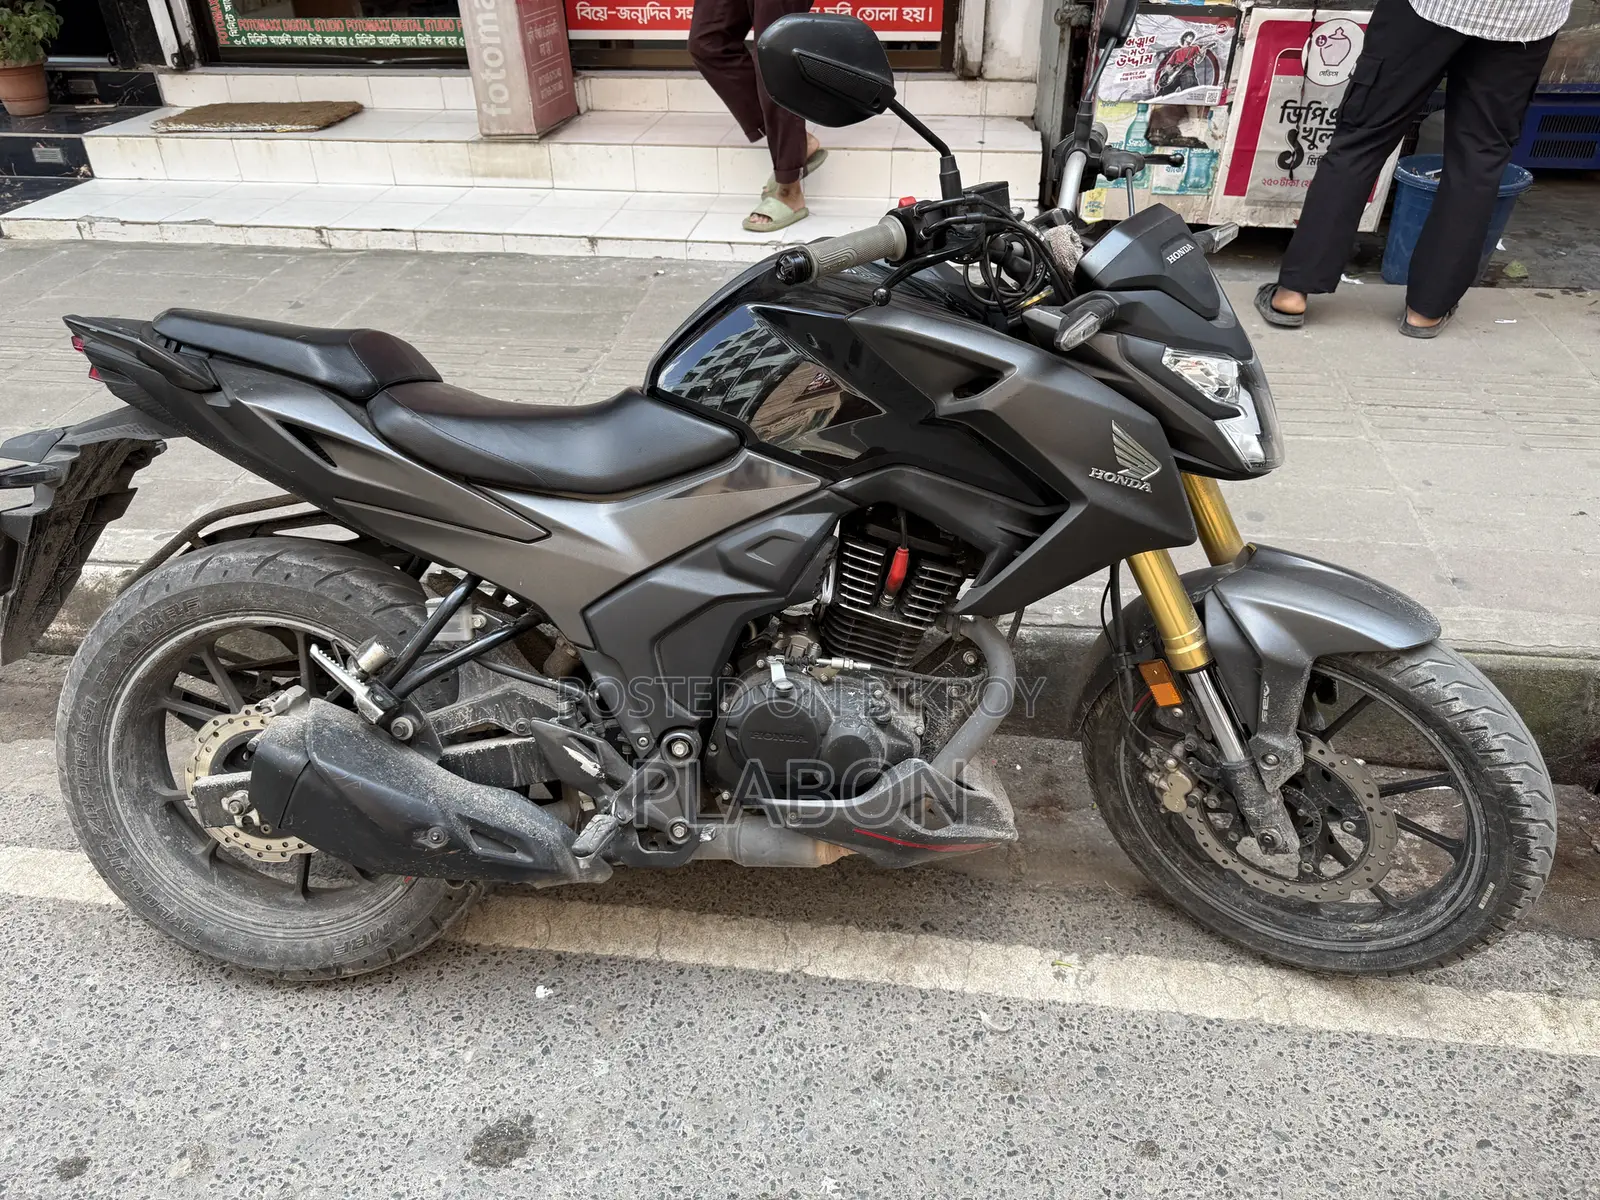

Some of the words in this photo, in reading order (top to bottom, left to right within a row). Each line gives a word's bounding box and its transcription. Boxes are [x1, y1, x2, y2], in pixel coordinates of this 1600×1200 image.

[575, 1, 671, 25] বিয়ে-জন্মদিন
[857, 6, 899, 21] তোলা
[238, 18, 282, 31] FOTOMAXX
[282, 19, 314, 32] DIGITAL
[314, 19, 345, 32] STUDIO
[345, 18, 391, 32] FOTOMAXX
[391, 18, 424, 32] DIGITAL
[424, 18, 455, 32] STUDIO
[247, 32, 268, 45] মিনিটে
[324, 36, 337, 46] করা
[355, 33, 376, 46] মিনিটে
[433, 36, 447, 47] করা
[1278, 99, 1339, 126] ডিপিএ
[1262, 178, 1279, 186] ২৫০
[1280, 176, 1300, 187] টাকা
[1166, 243, 1195, 264] HONDA
[1088, 467, 1153, 493] HONDA
[139, 596, 201, 635] MRF
[748, 731, 809, 744] HONDA
[100, 843, 204, 938] NYLOGRIP
